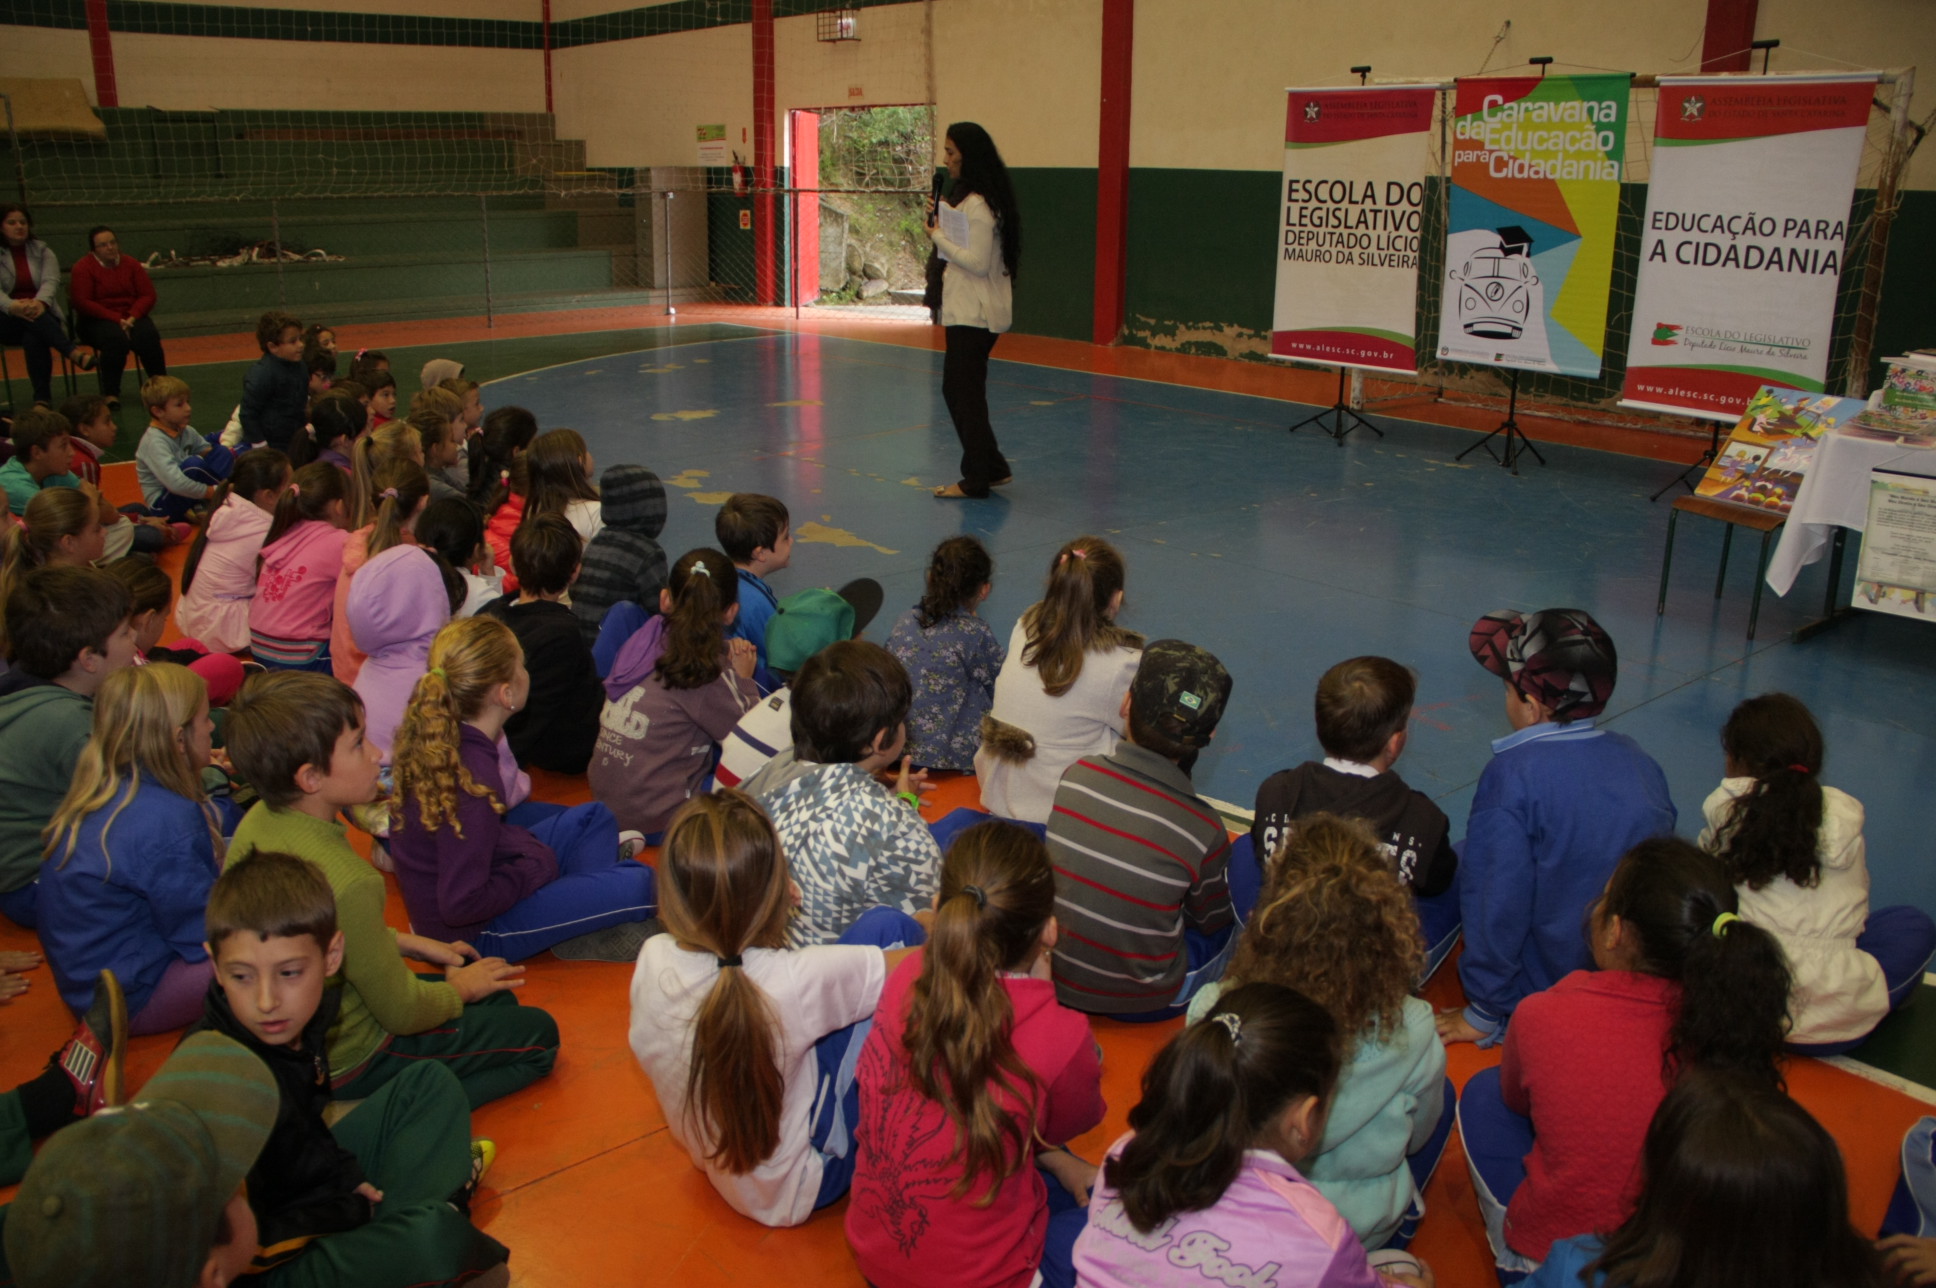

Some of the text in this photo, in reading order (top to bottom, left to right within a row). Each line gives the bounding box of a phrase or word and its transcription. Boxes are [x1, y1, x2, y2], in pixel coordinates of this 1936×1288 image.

[1482, 94, 1618, 123] Caravana
[1456, 114, 1615, 153] da Educação
[1454, 150, 1620, 181] para Cidadania
[1287, 179, 1423, 207] ESCOLA DO
[1285, 205, 1421, 233] LEGISLATIVO
[1651, 211, 1845, 242] EDUCAÇÃO PARA
[1284, 229, 1420, 253] DEPUTADO LÍCIO
[1283, 247, 1419, 269] MAURO DA SILVEIRA
[1648, 239, 1839, 276] A CIDADANIA
[1683, 337, 1716, 351] Deputado
[1737, 344, 1764, 355] Mauro
[1765, 346, 1775, 356] da
[1778, 348, 1809, 360] Silveira
[1685, 325, 1811, 347] ESCOLA DO LEGISLATIVO
[1291, 342, 1394, 359] www.alesc.sc.gov.br
[1637, 384, 1754, 406] www.alesc.sc.gov.b
